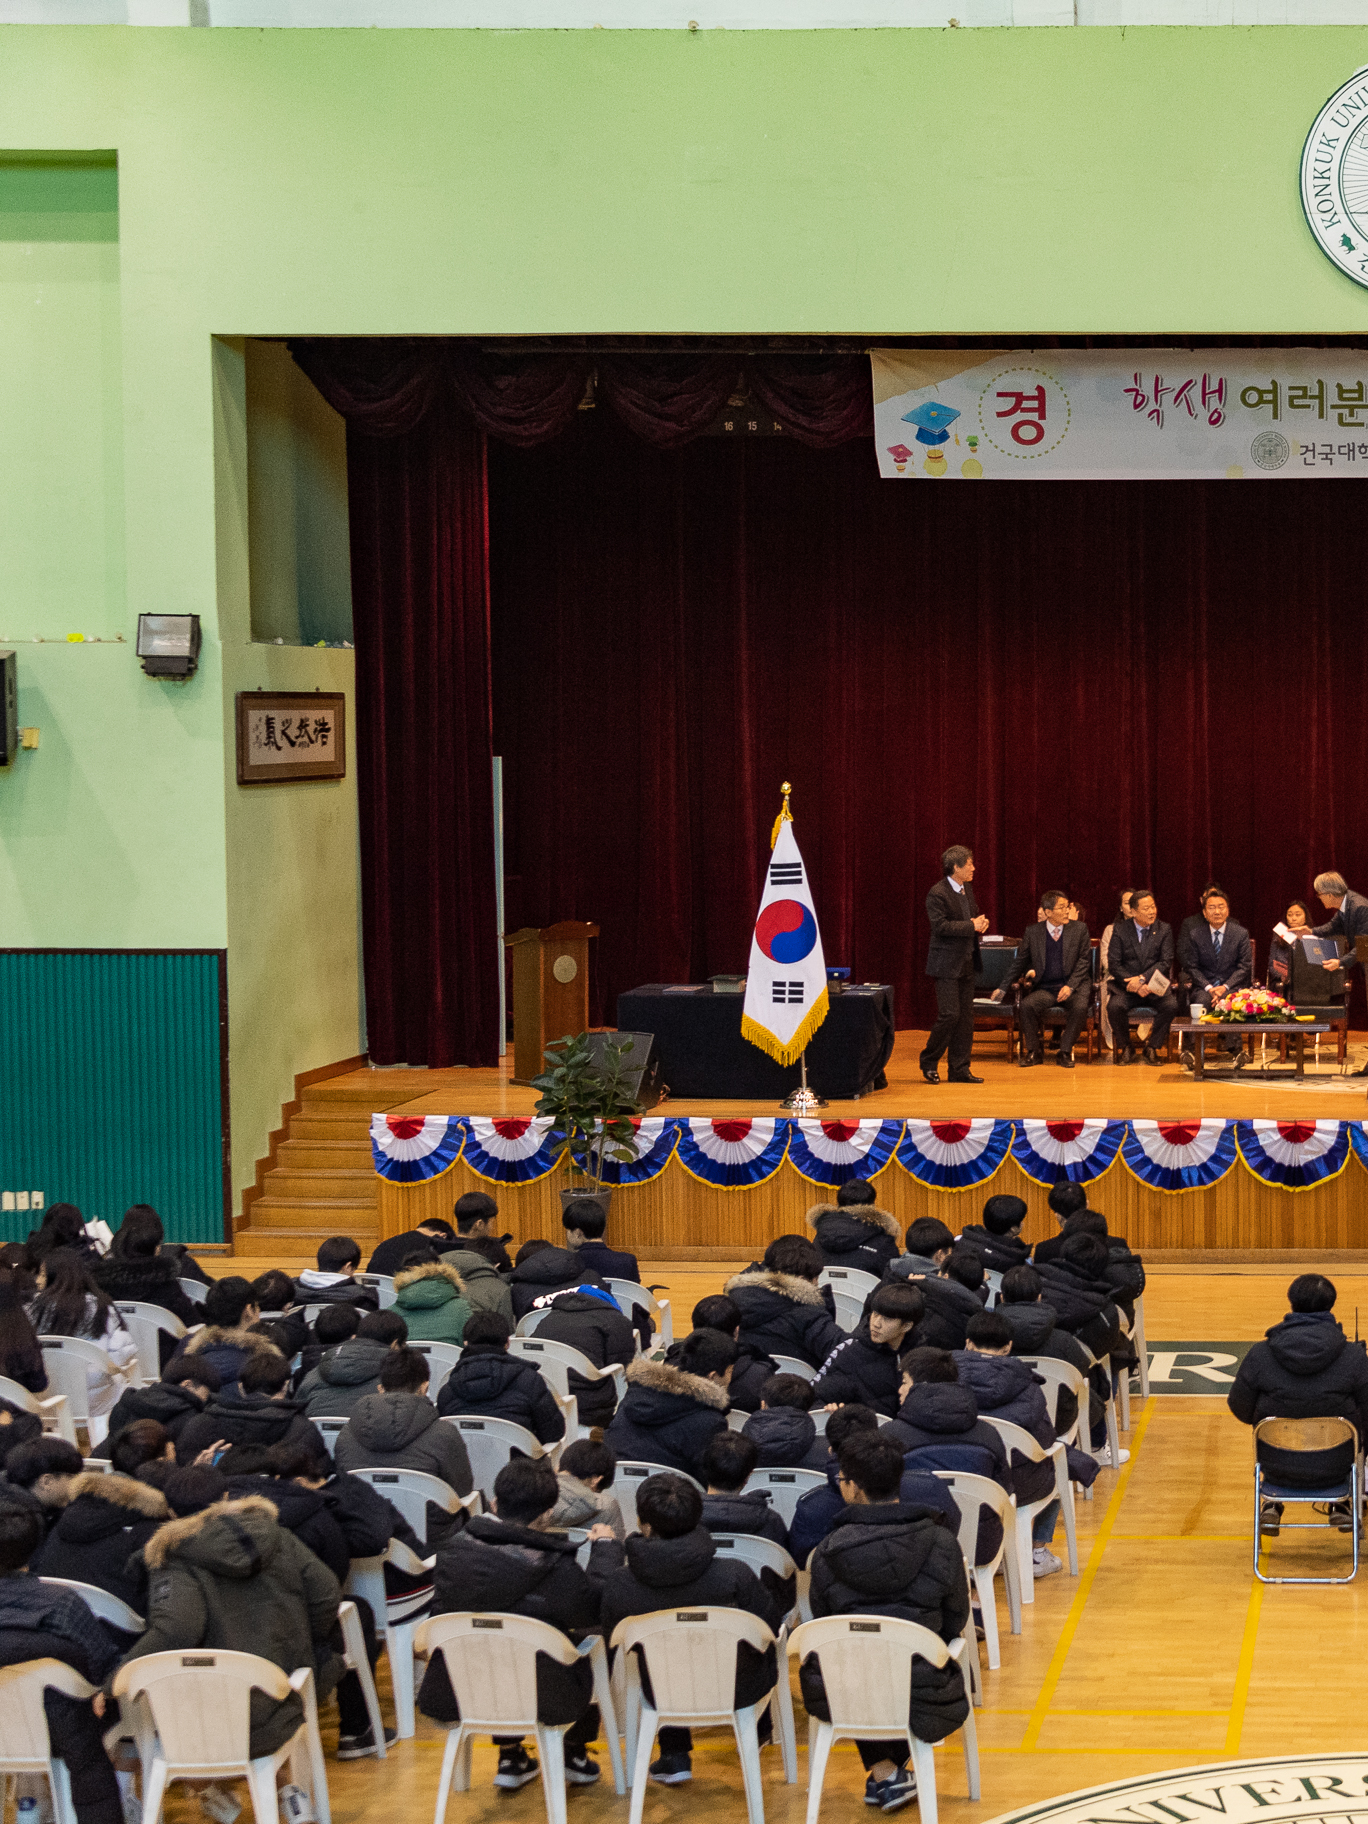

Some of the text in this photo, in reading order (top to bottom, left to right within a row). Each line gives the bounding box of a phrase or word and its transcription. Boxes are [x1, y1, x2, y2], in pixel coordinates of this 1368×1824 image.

[1312, 132, 1341, 230] KONKUK
[724, 421, 734, 431] 16
[747, 421, 758, 431] 15
[995, 384, 1048, 447] 경
[1123, 372, 1228, 428] 학생
